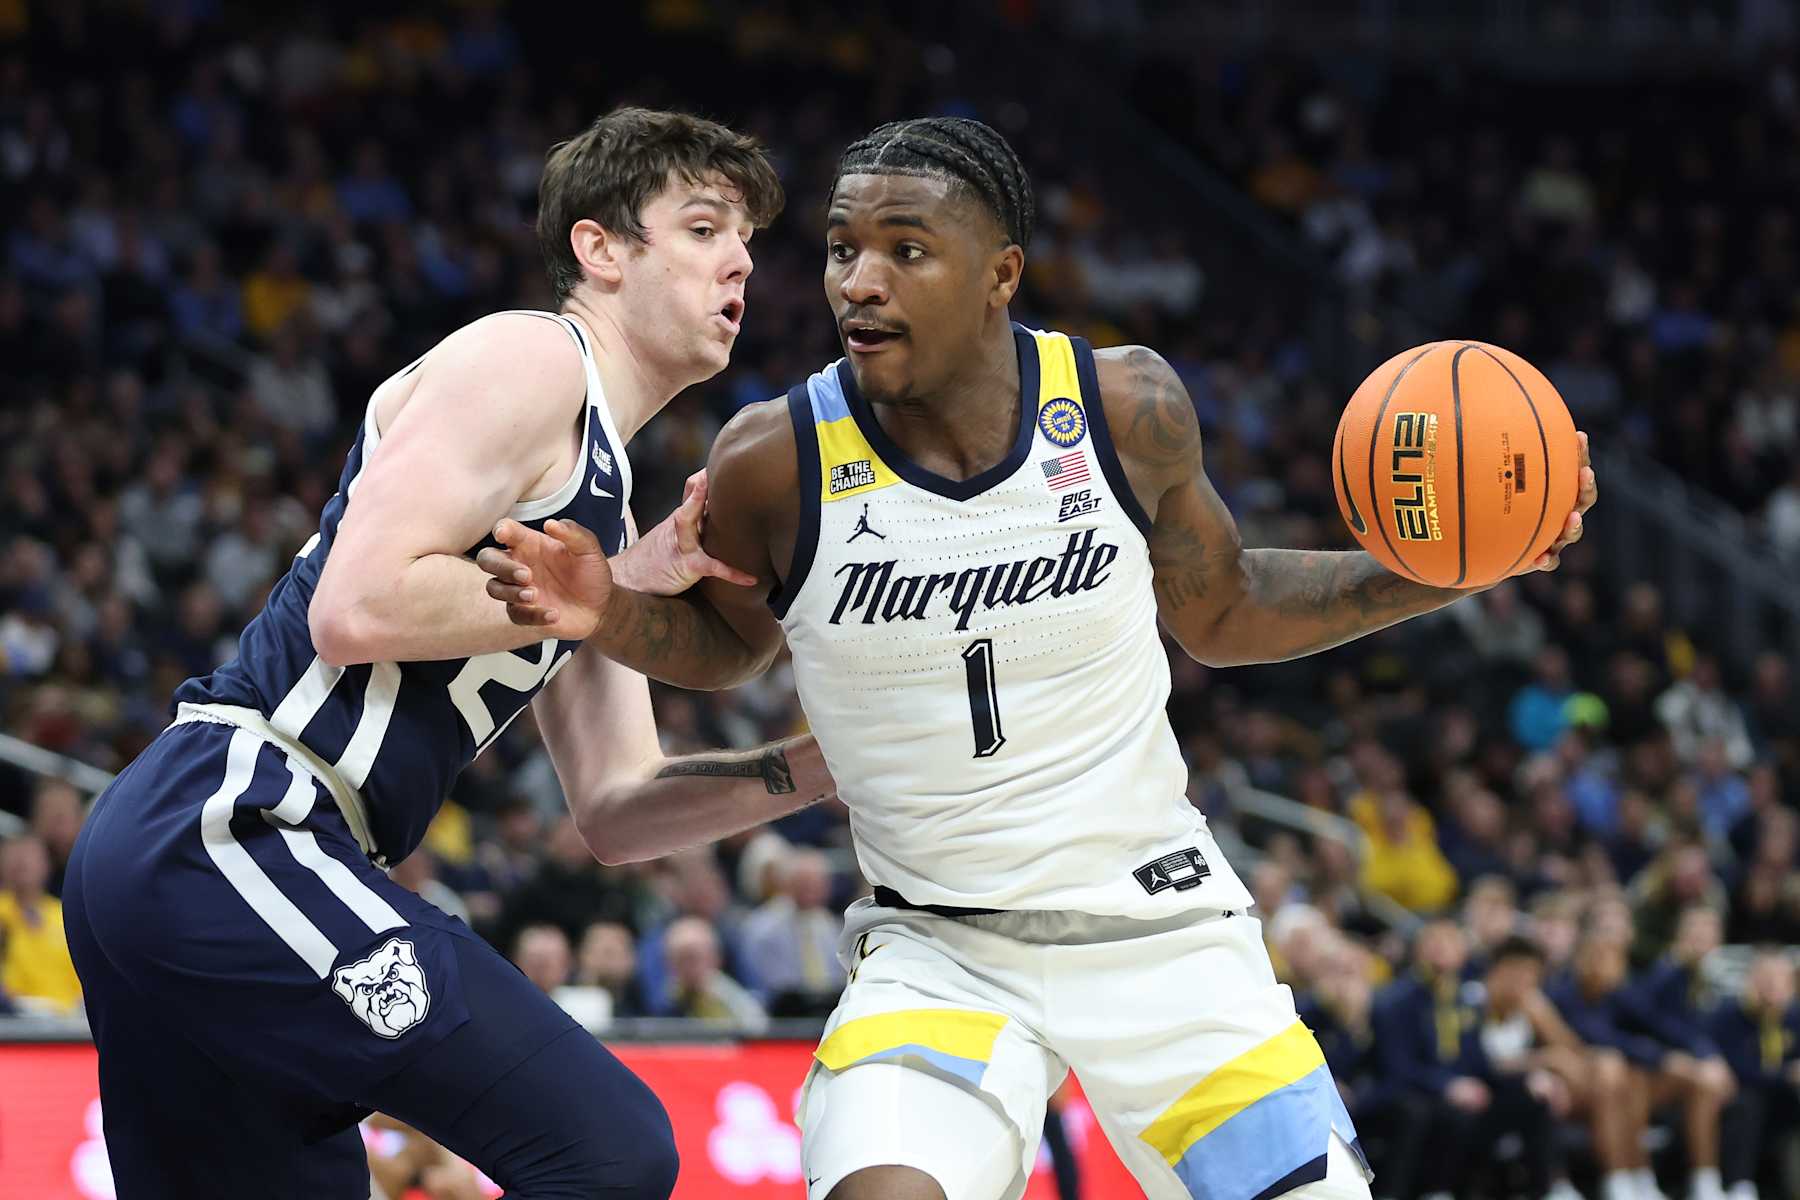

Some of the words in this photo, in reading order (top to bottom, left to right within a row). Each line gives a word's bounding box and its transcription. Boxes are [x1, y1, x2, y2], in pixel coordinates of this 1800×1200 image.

[830, 465, 845, 481] BE
[846, 460, 871, 476] THE
[830, 471, 875, 494] CHANGE
[1061, 488, 1092, 506] BIG
[1392, 412, 1431, 541] ELITE
[1058, 497, 1102, 518] EAST
[828, 527, 1119, 631] Marquette
[447, 637, 573, 762] 2
[961, 638, 1006, 759] 1
